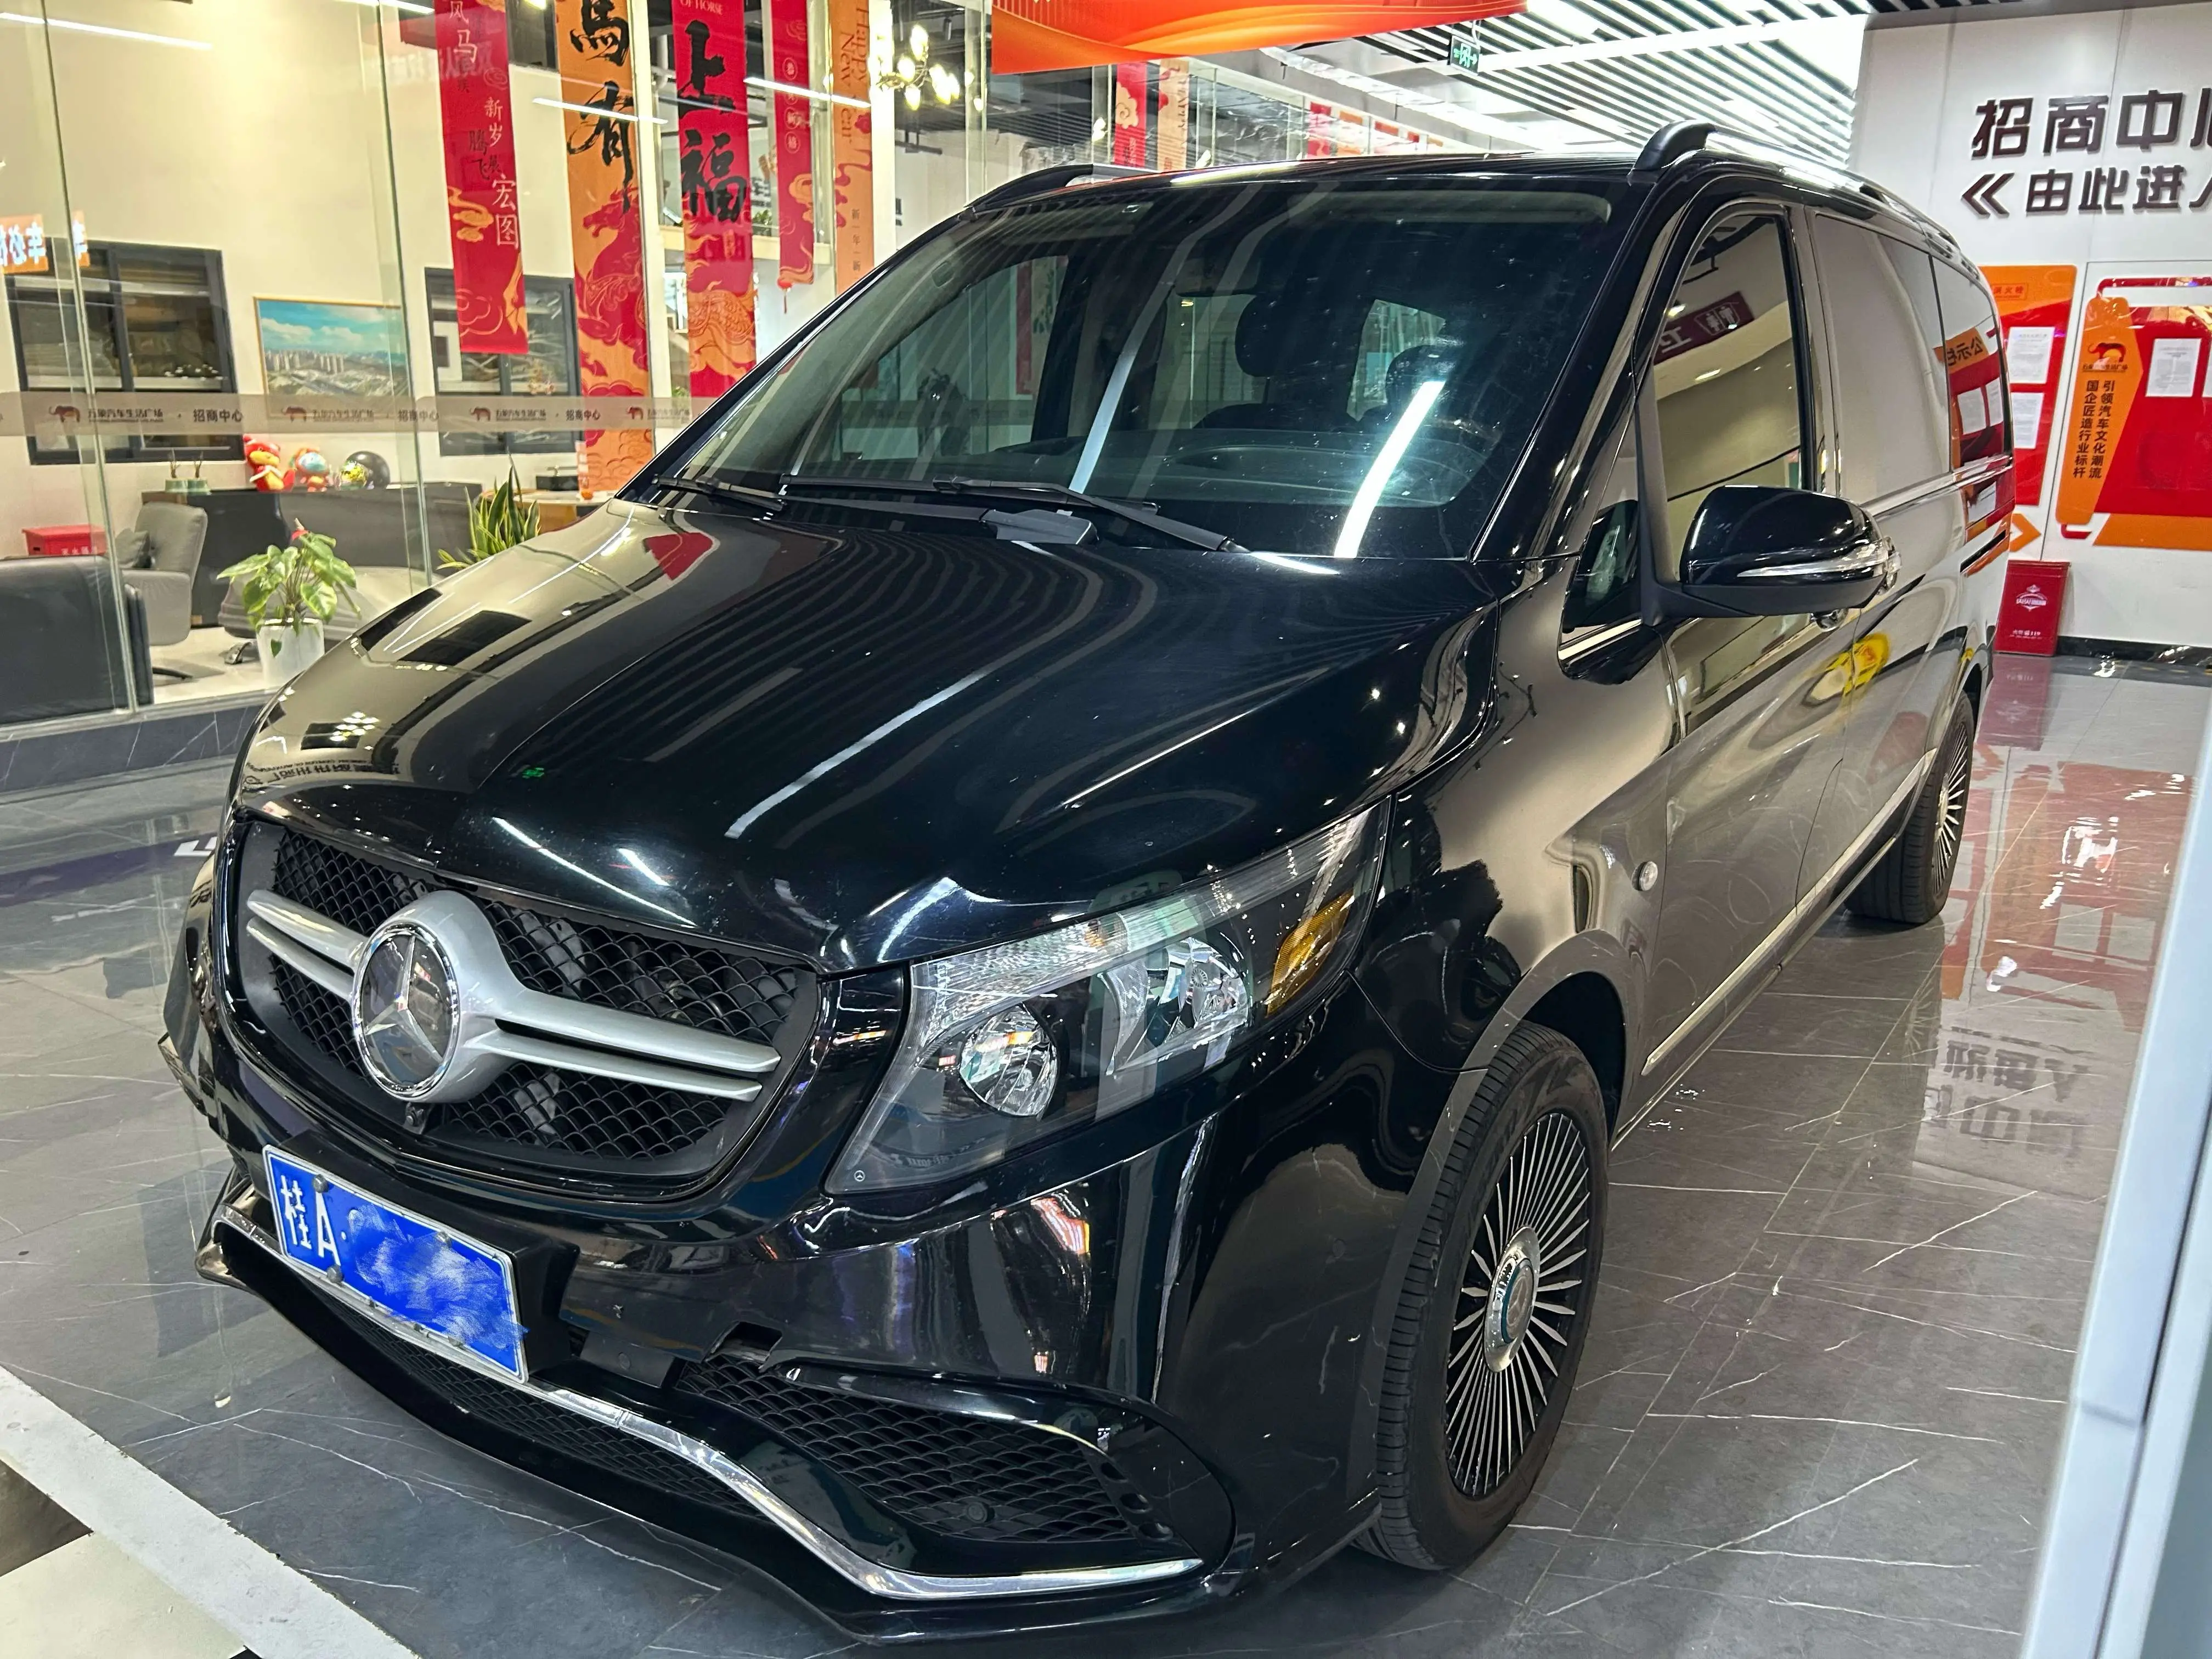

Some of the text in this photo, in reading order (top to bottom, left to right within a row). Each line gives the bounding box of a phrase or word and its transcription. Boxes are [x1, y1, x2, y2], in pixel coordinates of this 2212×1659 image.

[840, 31, 854, 87] New
[492, 173, 520, 249] 宏图
[193, 408, 242, 422] 招商中心
[566, 409, 601, 421] 招商中心
[2073, 380, 2100, 478] 国企匠造行业标杆
[2089, 380, 2115, 479] 引领汽车文化潮流
